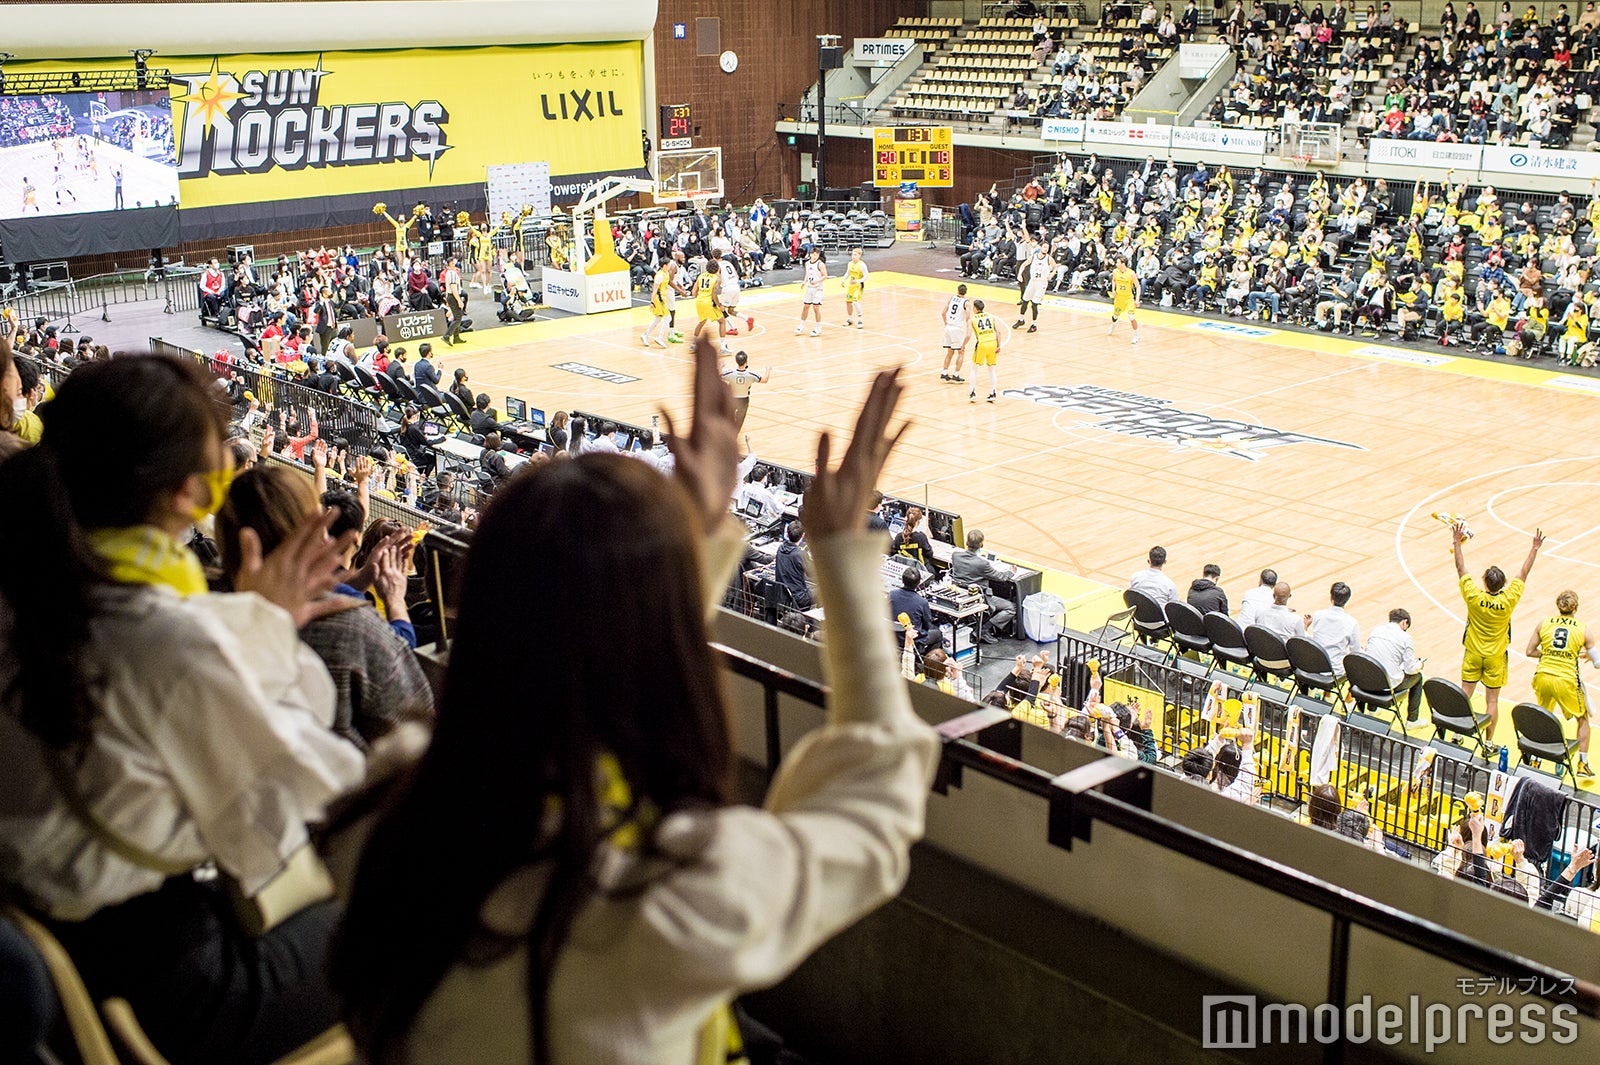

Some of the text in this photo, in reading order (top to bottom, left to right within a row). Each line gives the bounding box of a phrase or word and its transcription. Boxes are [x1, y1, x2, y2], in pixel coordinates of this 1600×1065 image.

[241, 69, 314, 107] SUN
[540, 88, 623, 122] LIXIL
[670, 118, 688, 136] 24
[1054, 126, 1080, 134] NISHIO
[908, 129, 930, 141] 1:37
[880, 151, 897, 164] 20
[937, 151, 949, 164] 18
[1390, 146, 1417, 159] ITOKI
[701, 278, 710, 288] 14
[547, 283, 579, 298] 日立キャピタル
[594, 289, 626, 304] LIXIL
[951, 304, 958, 315] 9
[396, 314, 434, 328] バスケット
[978, 318, 992, 330] 44
[411, 325, 433, 337] LIVE
[1480, 600, 1505, 610] LIXIL
[1551, 617, 1578, 626] LIXIL
[1552, 627, 1568, 649] 9
